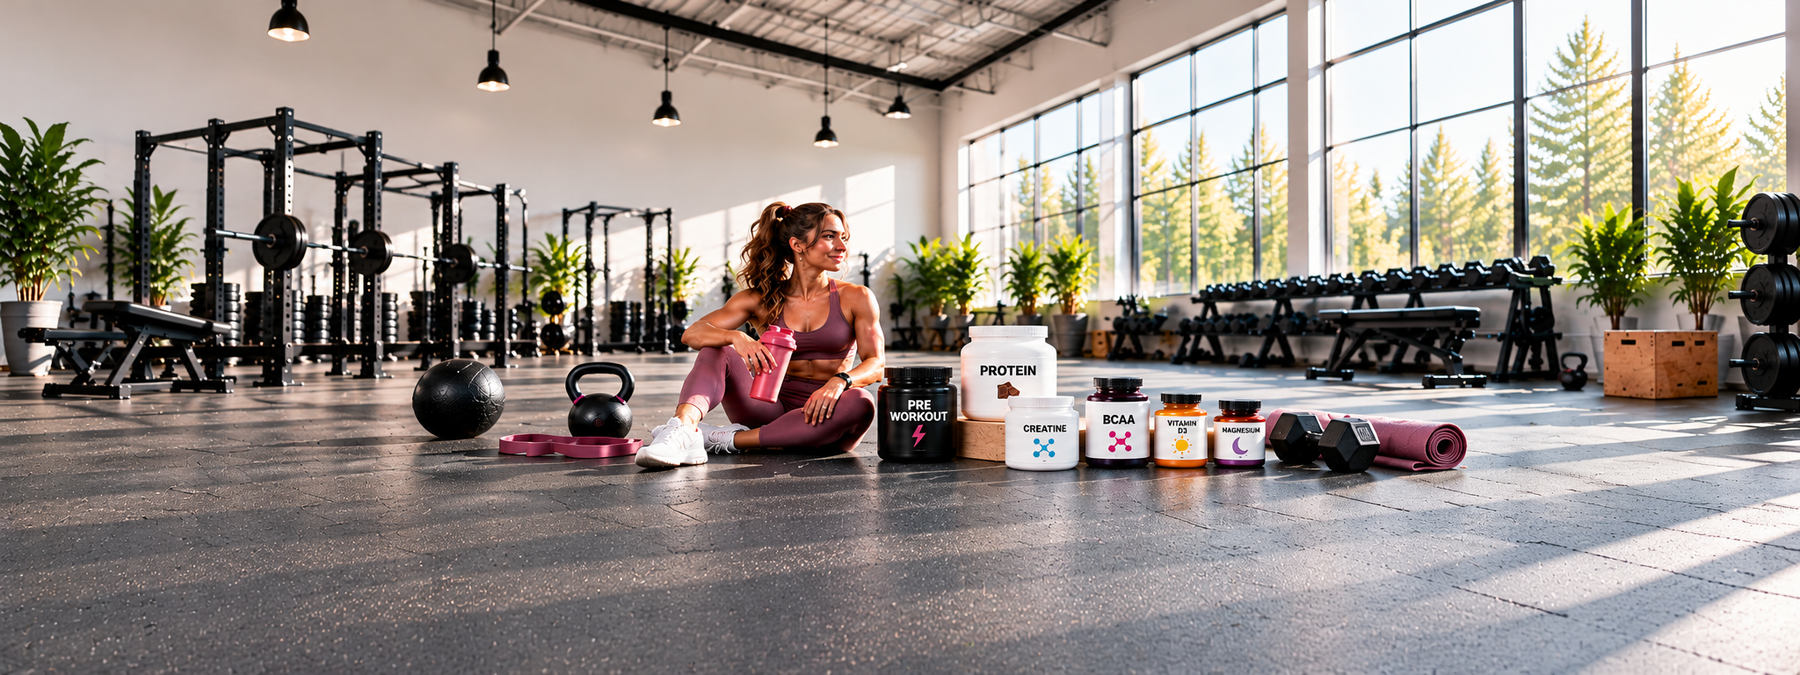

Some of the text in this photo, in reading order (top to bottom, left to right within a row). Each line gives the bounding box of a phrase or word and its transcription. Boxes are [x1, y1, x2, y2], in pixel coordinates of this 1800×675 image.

[980, 365, 1037, 376] PROTEIN
[908, 400, 931, 410] PRE
[890, 411, 949, 422] WORKOUT
[1103, 415, 1135, 425] BCAA
[1023, 424, 1067, 433] CREATINE
